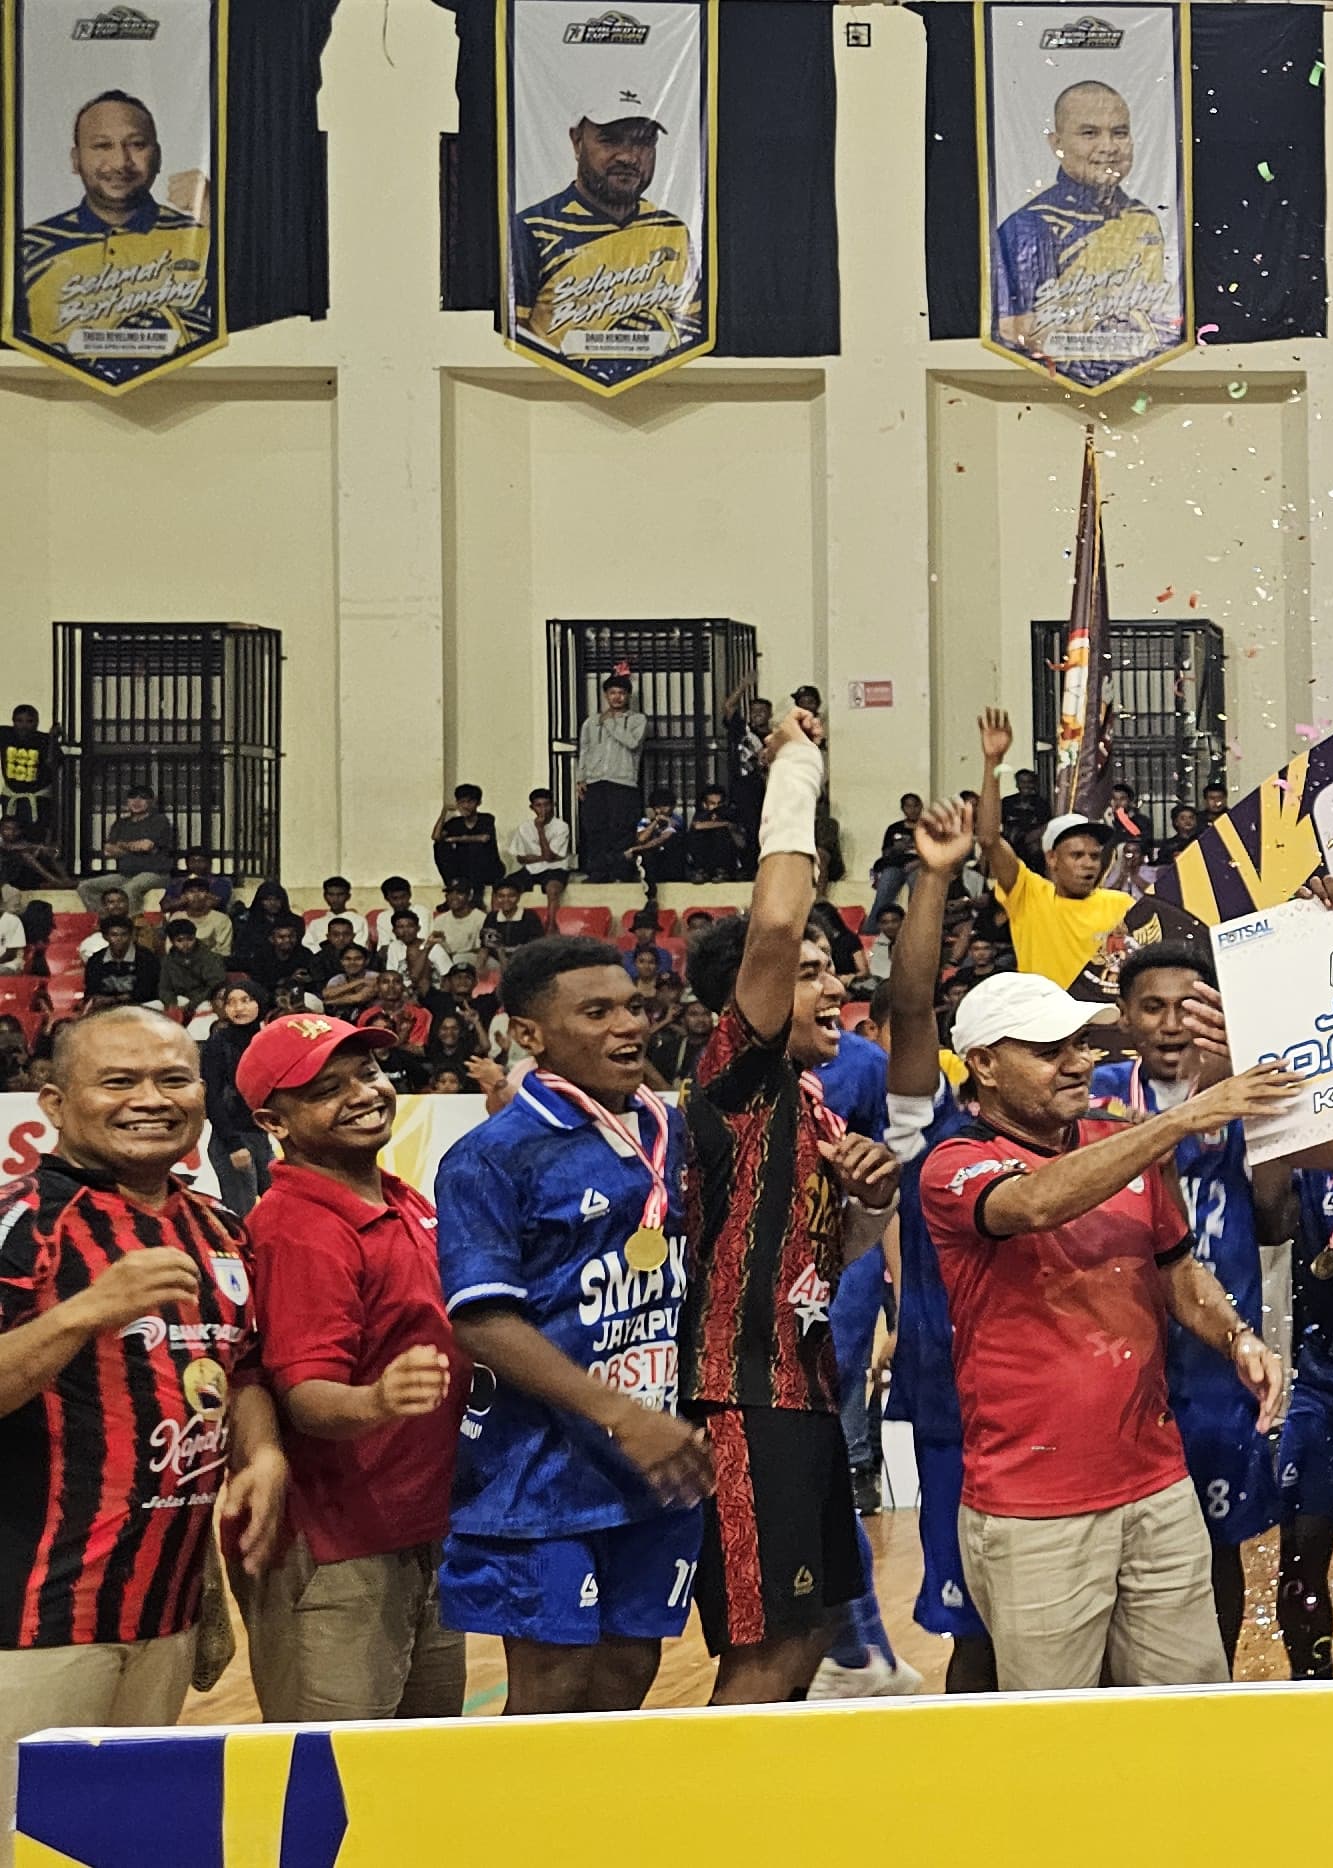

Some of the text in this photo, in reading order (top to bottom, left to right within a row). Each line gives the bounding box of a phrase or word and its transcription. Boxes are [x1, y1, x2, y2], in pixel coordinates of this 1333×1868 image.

[65, 251, 171, 299] Selamat
[555, 248, 666, 298] Selamat
[58, 278, 208, 329] Bertanding
[548, 273, 694, 336] Bertanding
[578, 1249, 664, 1327] SMA
[1207, 1478, 1230, 1519] 8
